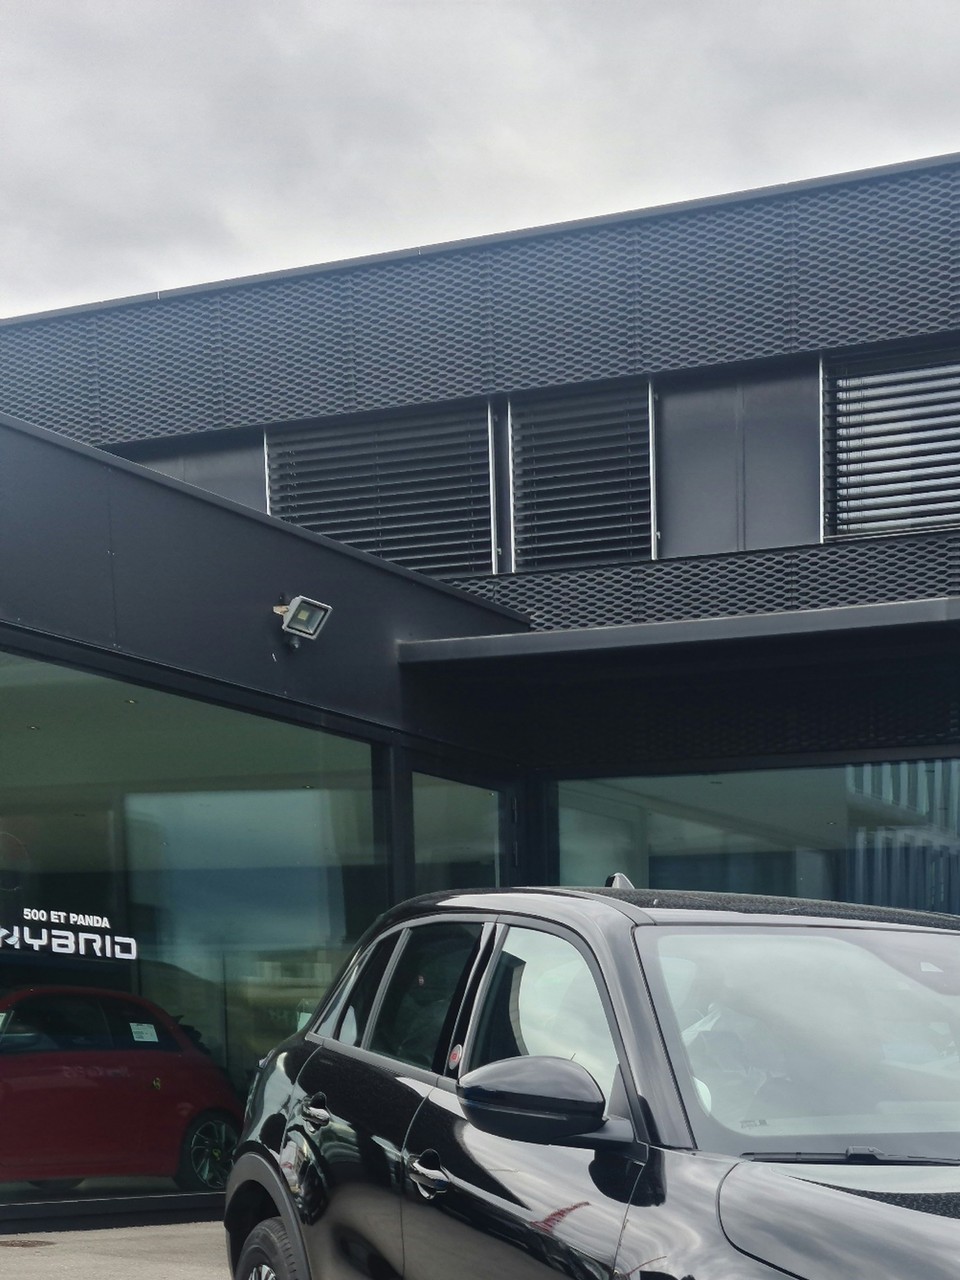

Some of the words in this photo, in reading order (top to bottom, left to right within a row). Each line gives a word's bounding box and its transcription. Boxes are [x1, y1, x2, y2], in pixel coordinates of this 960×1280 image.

[23, 908, 47, 921] 500
[50, 911, 66, 923] ET
[69, 912, 111, 928] PANDA
